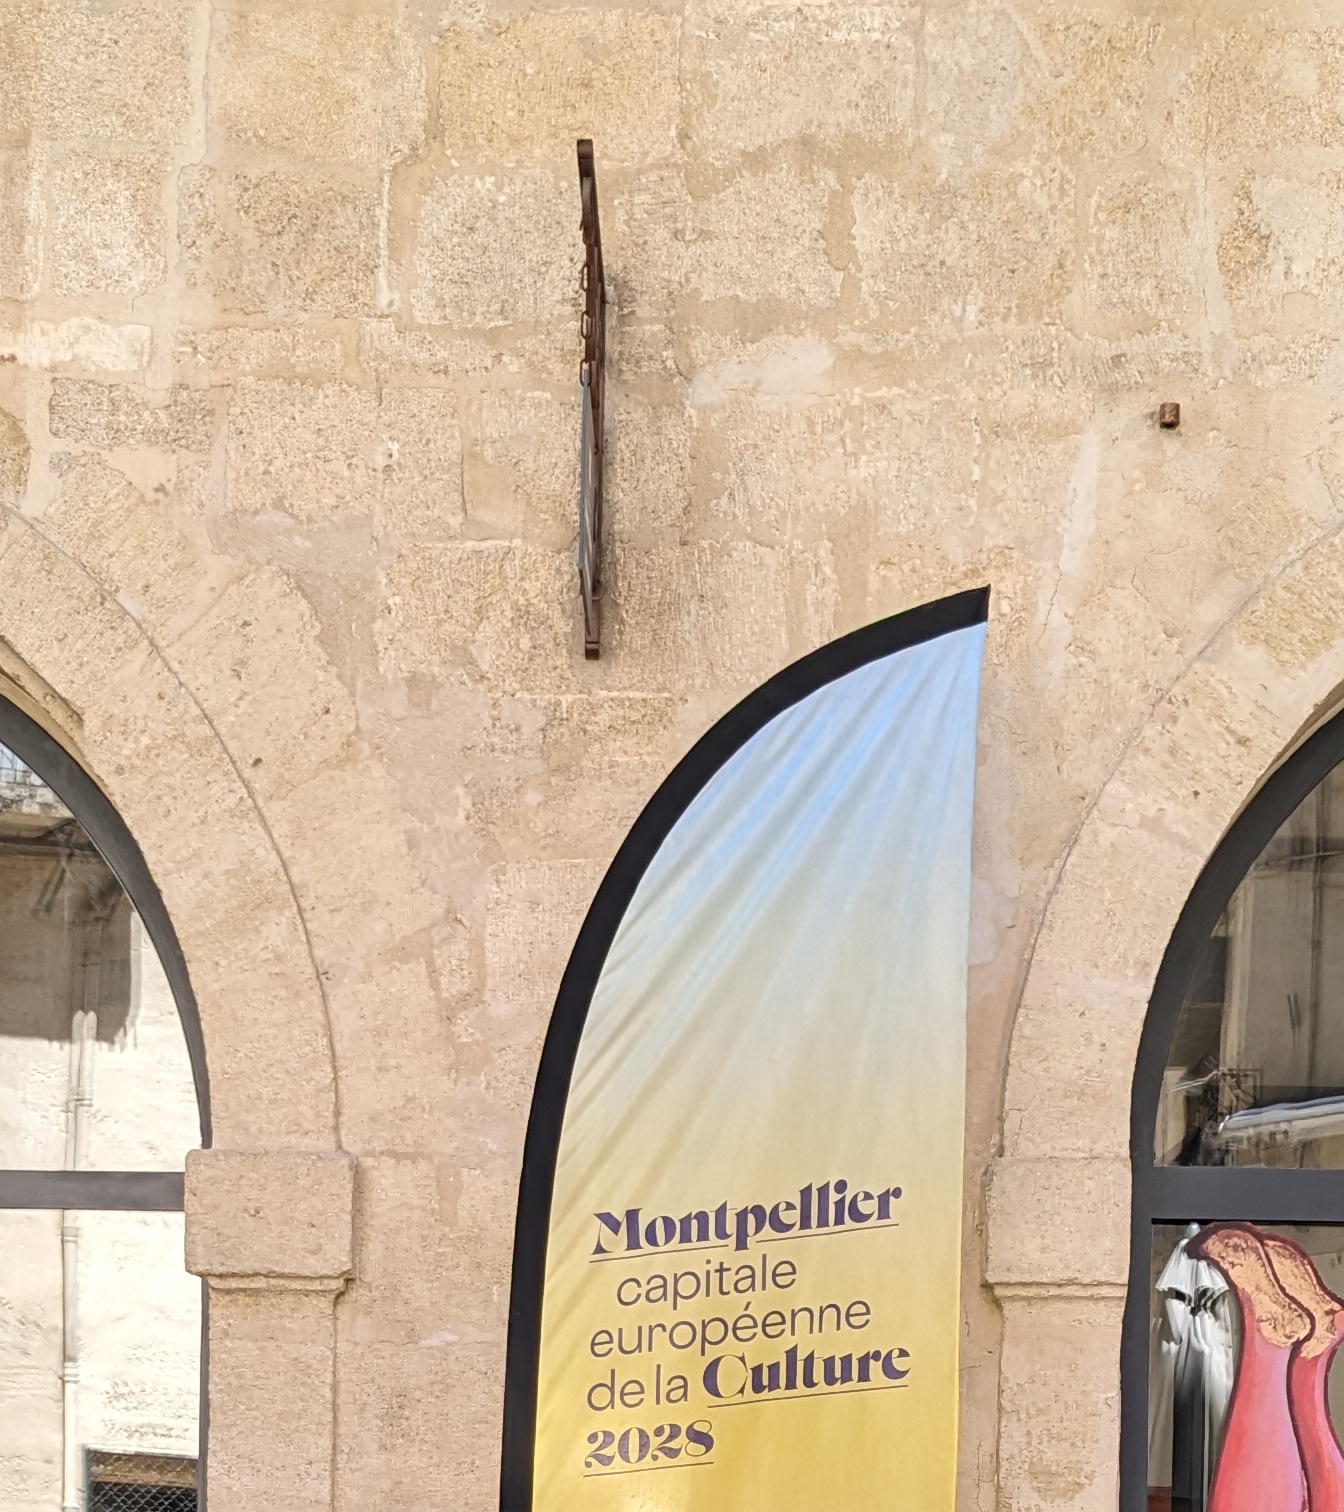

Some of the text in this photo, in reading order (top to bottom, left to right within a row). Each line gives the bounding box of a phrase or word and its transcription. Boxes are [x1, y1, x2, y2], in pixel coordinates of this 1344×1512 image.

[591, 1179, 902, 1256] Montpellier
[616, 1253, 797, 1311] capitale
[590, 1299, 871, 1358] européenne
[586, 1343, 911, 1412] de la Culture
[584, 1419, 715, 1469] 2028
